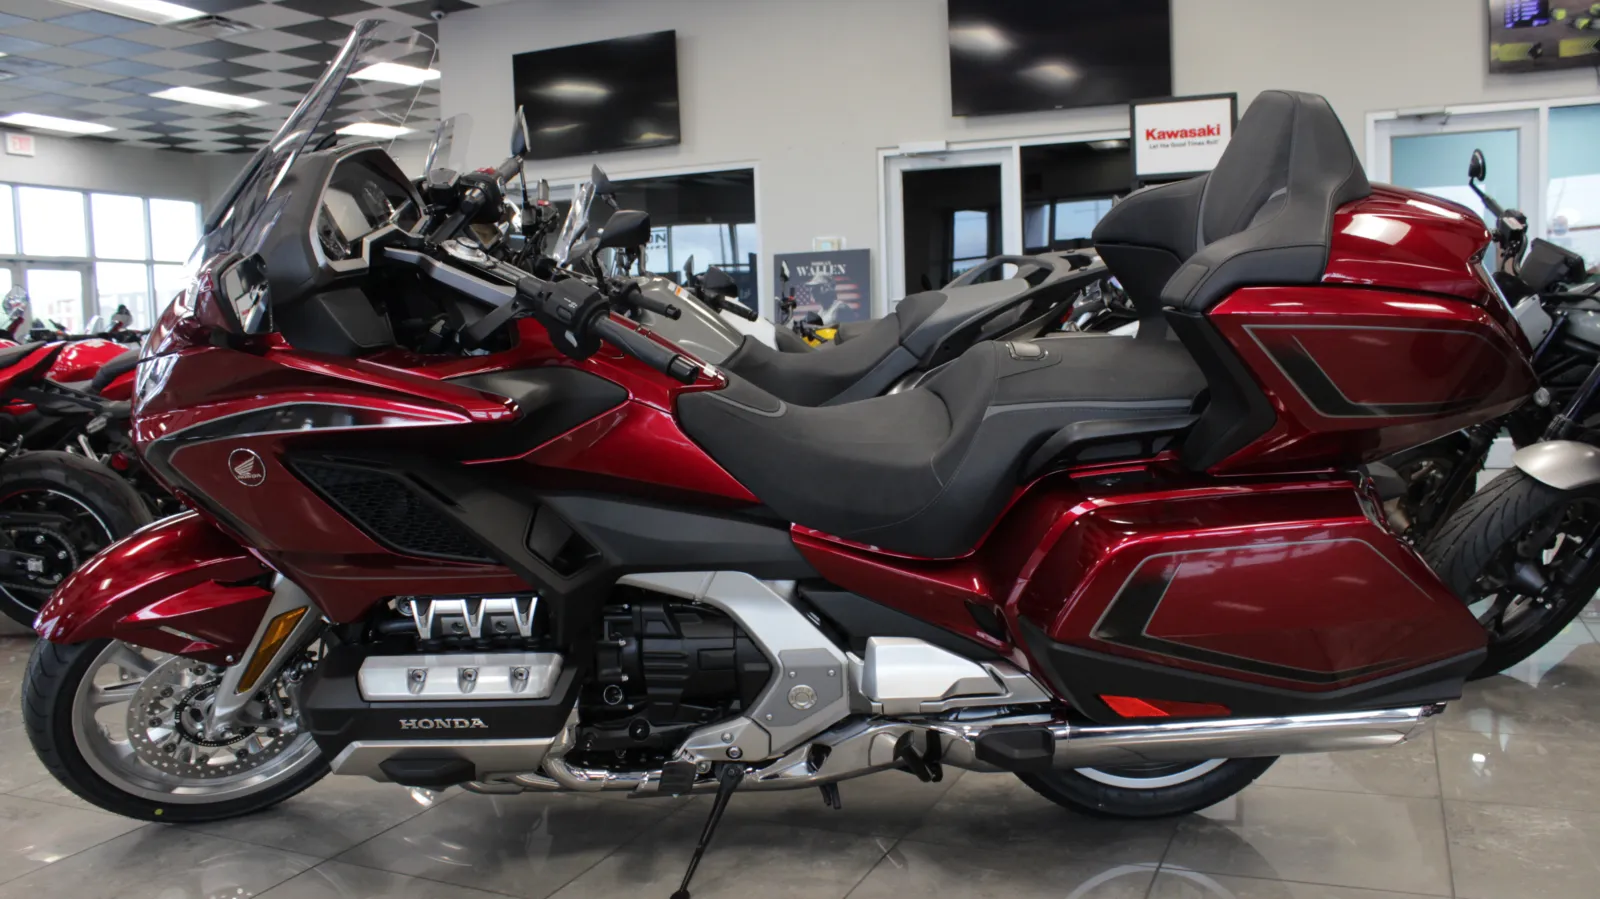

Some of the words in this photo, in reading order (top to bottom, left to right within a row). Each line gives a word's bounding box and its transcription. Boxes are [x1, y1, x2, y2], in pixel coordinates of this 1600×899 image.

[1145, 124, 1221, 141] Kawasaki
[796, 264, 847, 277] WALLEN
[399, 718, 489, 730] HONDA
